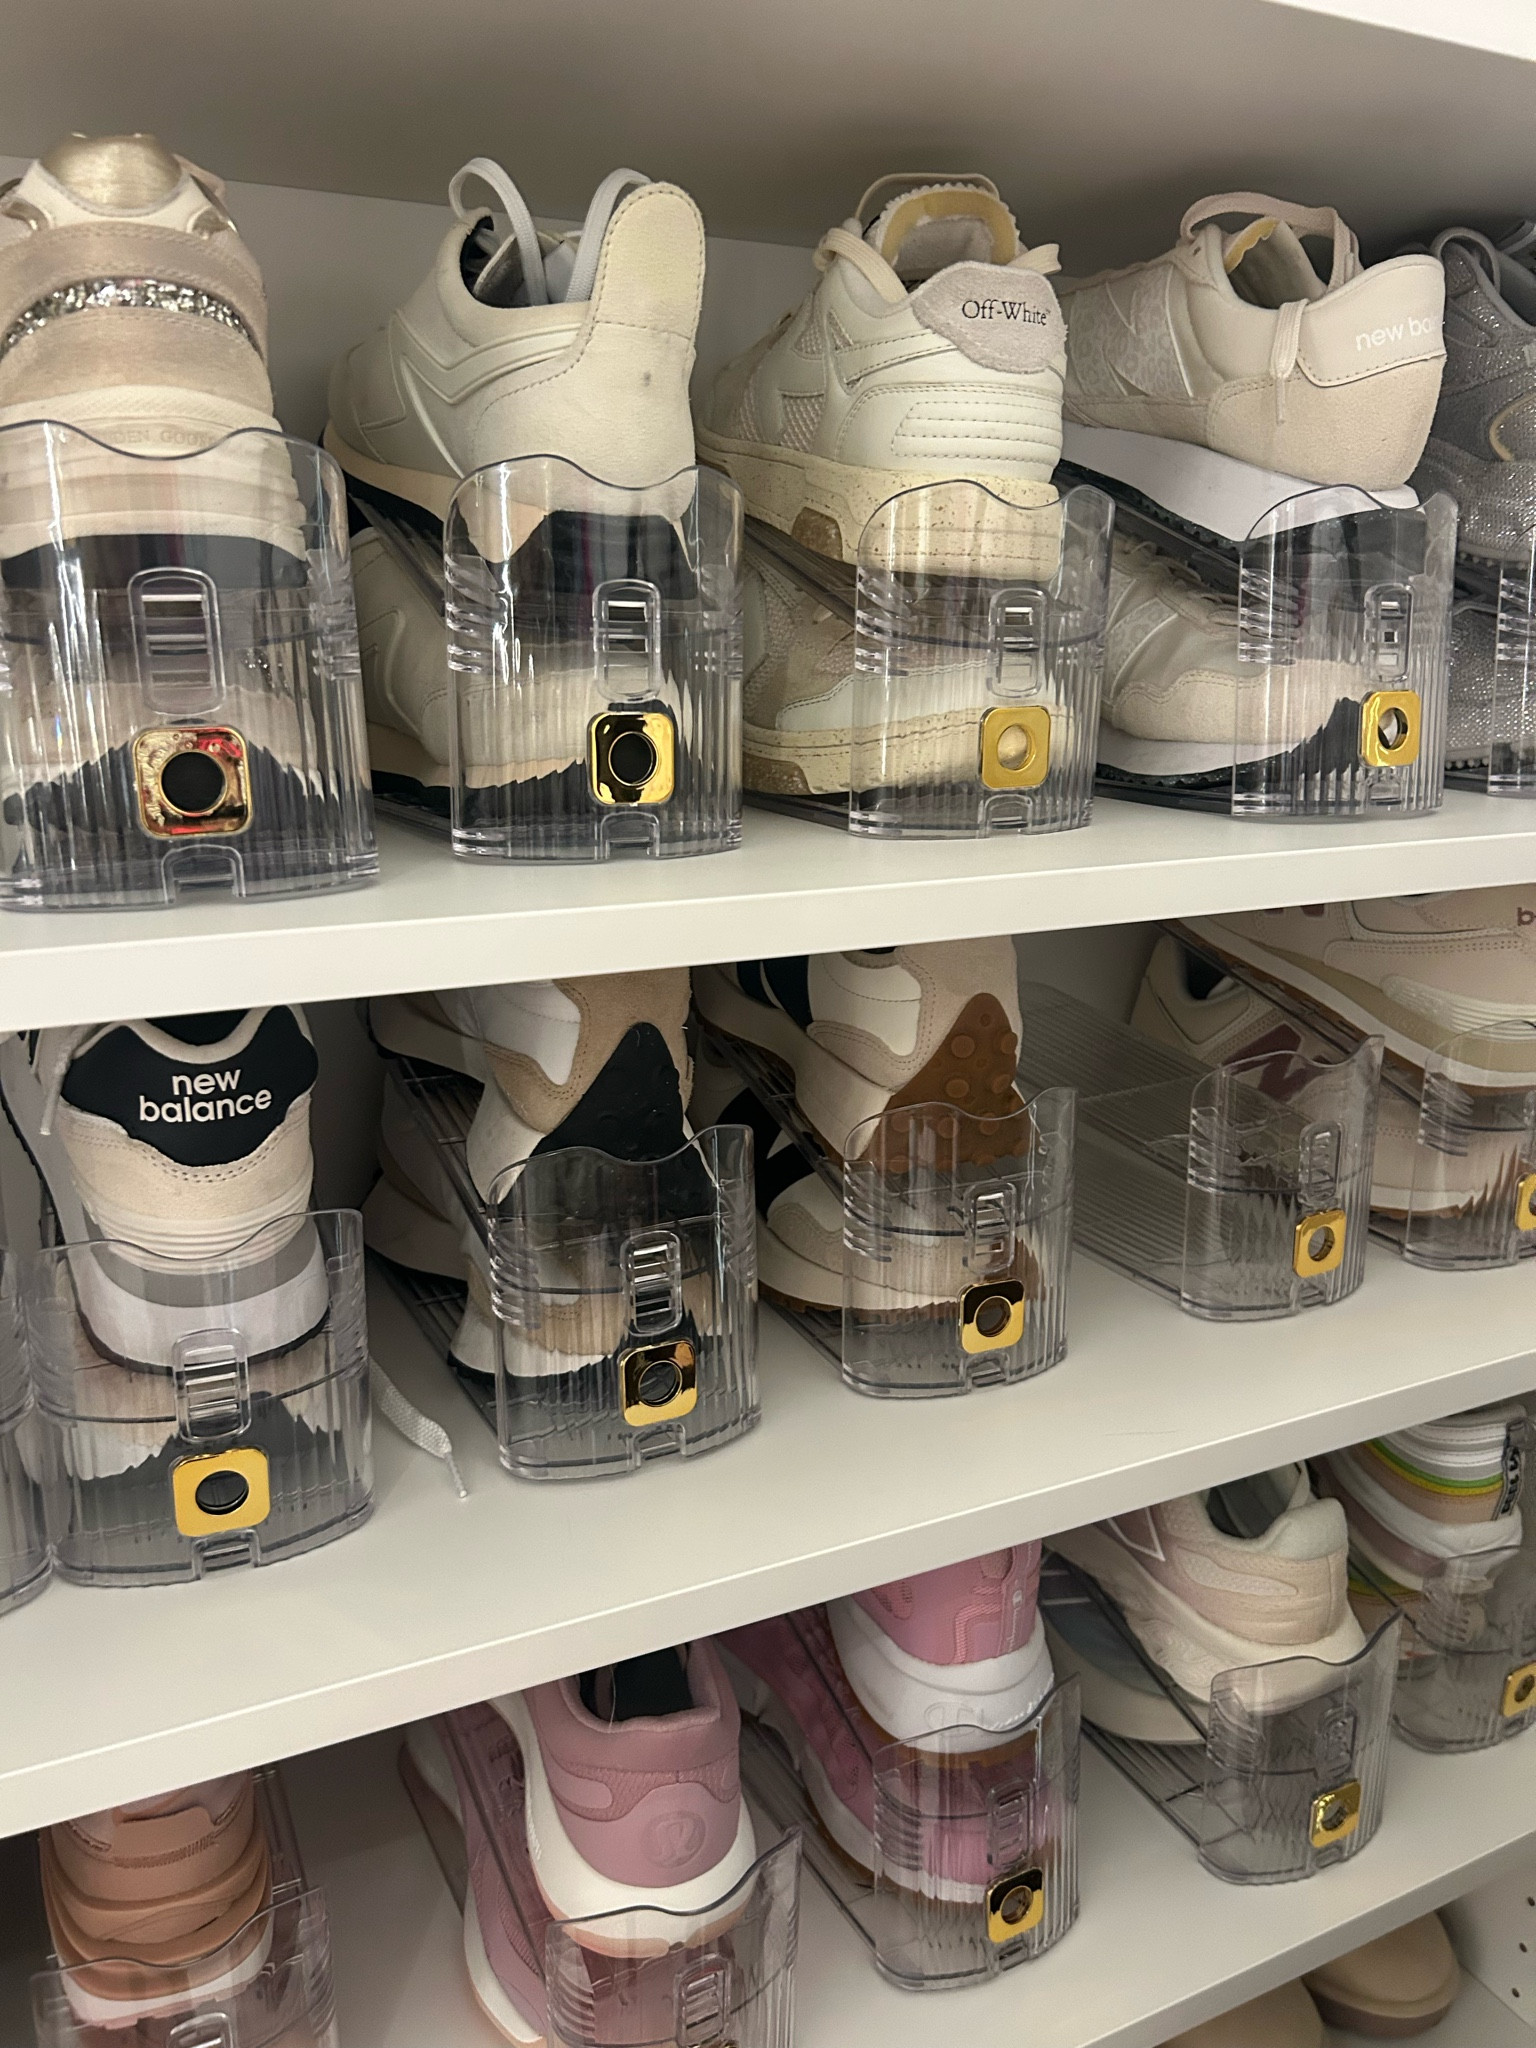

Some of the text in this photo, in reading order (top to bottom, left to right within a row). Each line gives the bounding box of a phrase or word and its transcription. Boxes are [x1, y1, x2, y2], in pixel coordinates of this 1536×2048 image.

[1355, 323, 1404, 351] new
[171, 1069, 241, 1096] new
[139, 1089, 272, 1123] balance
